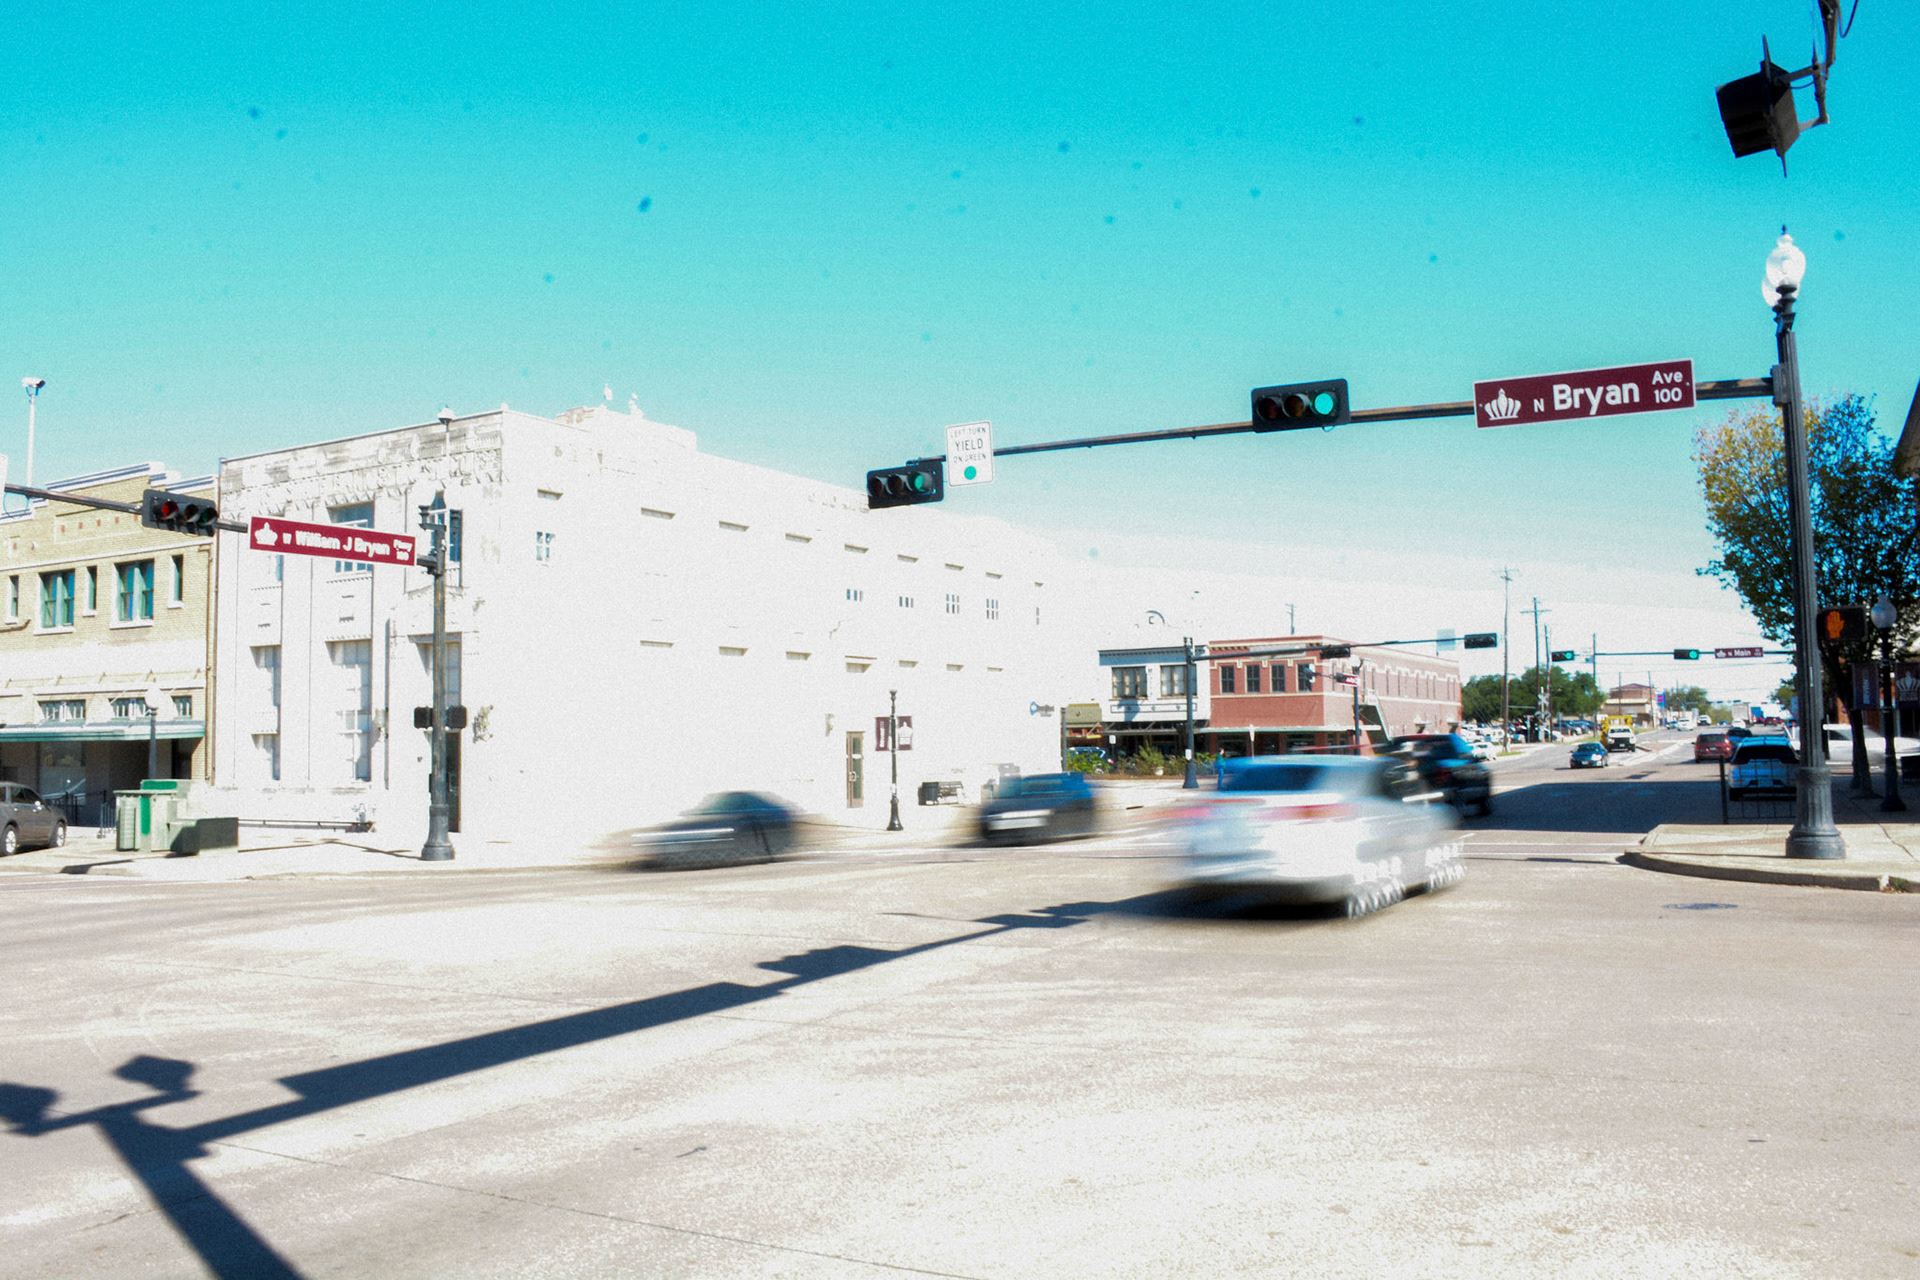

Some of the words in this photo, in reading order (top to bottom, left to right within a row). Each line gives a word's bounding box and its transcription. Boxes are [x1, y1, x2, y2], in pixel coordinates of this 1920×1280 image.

[1533, 398, 1545, 413] N
[1552, 381, 1640, 415] Bryan
[1652, 370, 1684, 386] Ave
[1654, 387, 1683, 404] 100
[954, 438, 984, 451] YIELD
[295, 530, 341, 550] William
[343, 536, 352, 551] J
[354, 537, 391, 558] Bryan
[1733, 649, 1752, 657] Main
